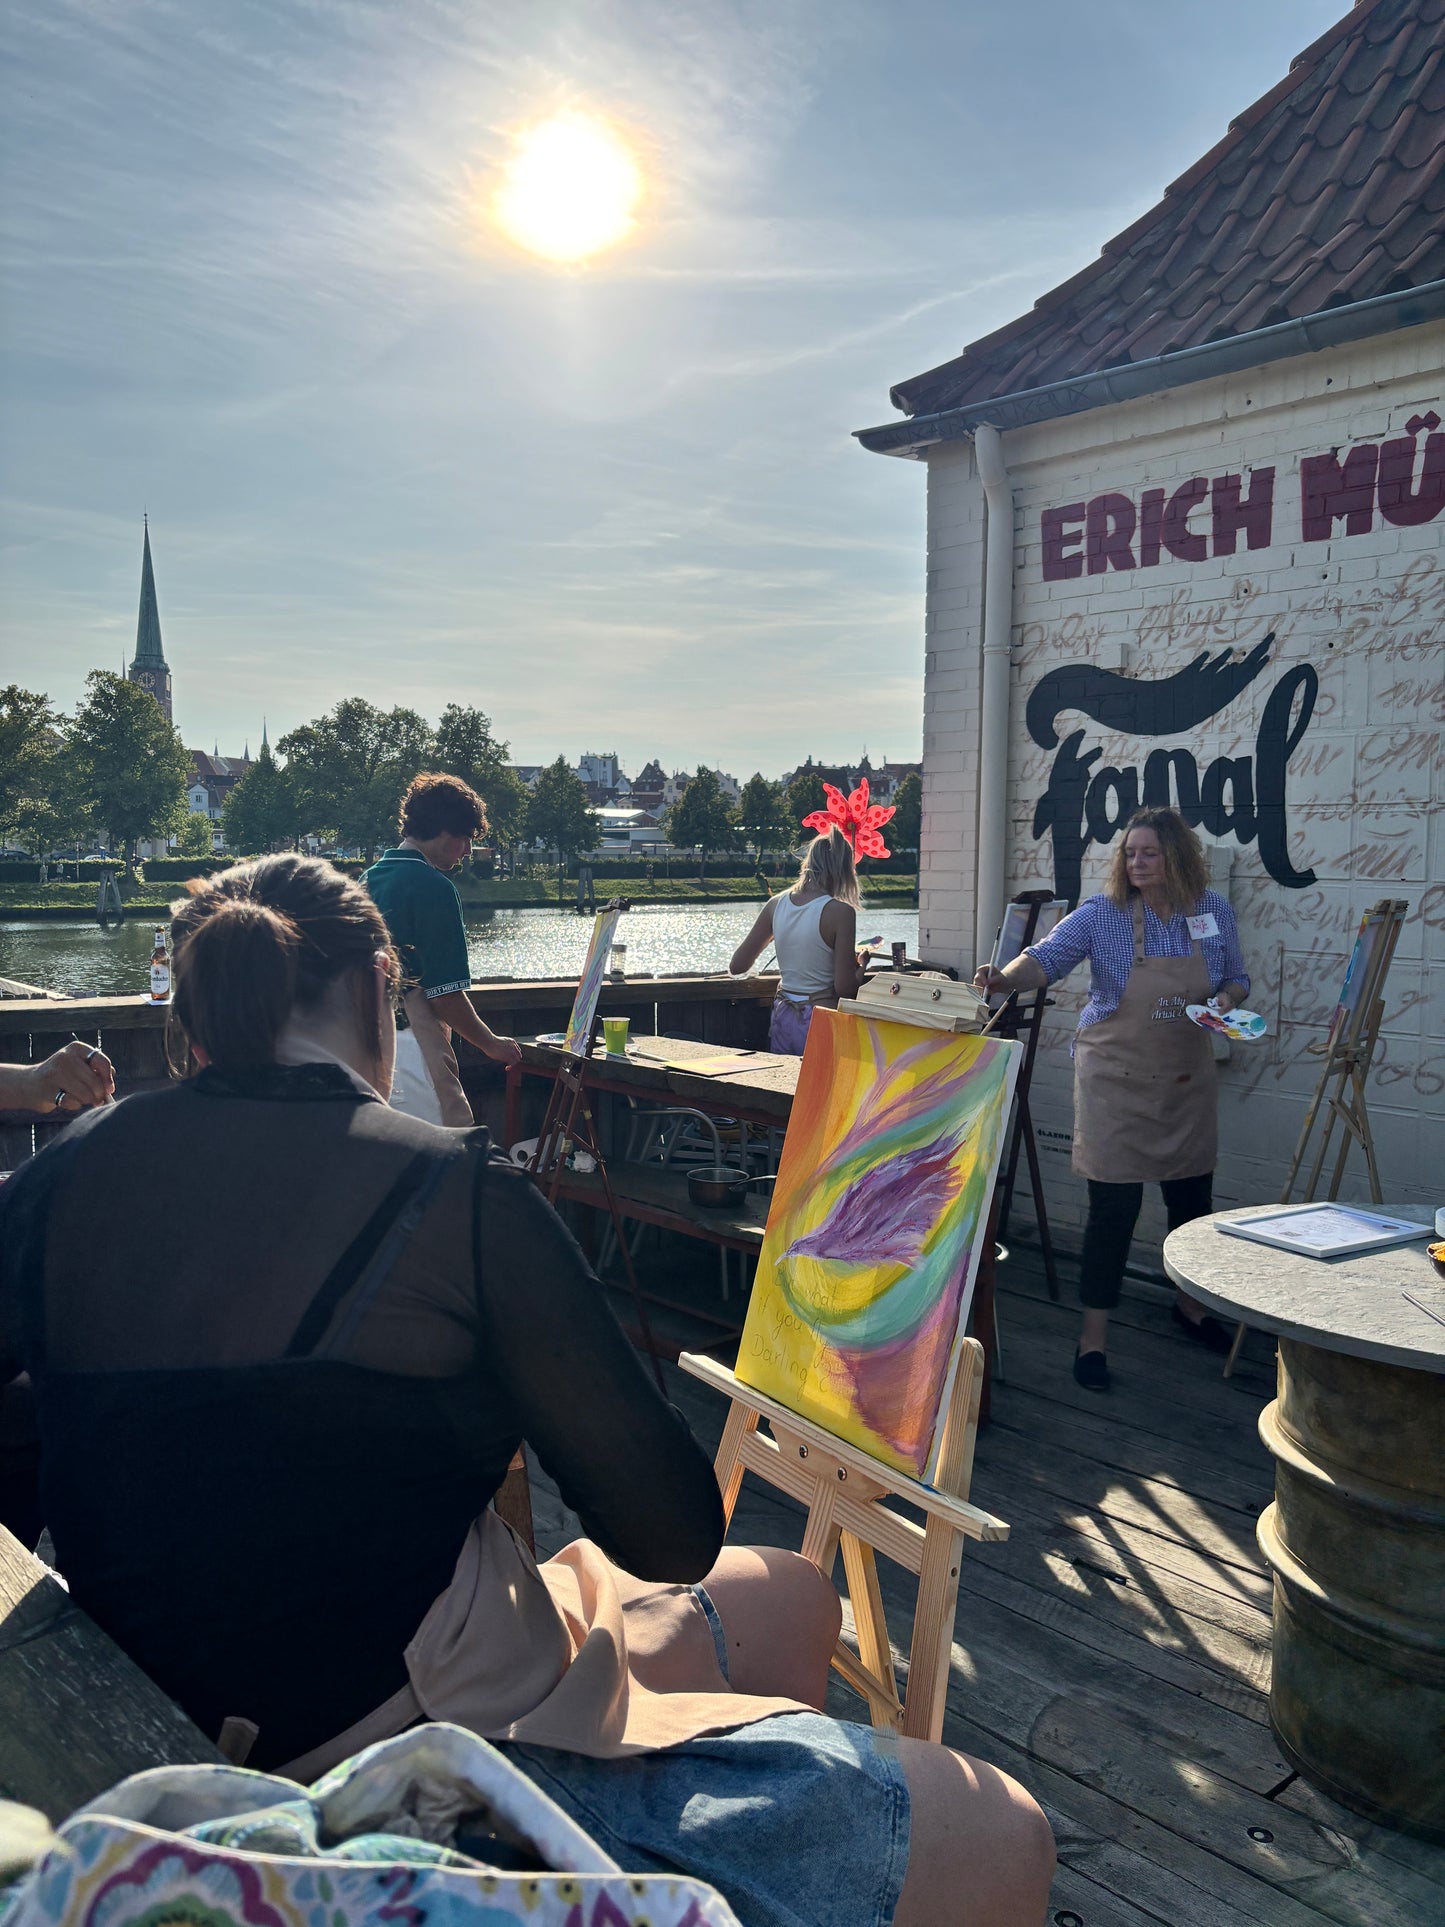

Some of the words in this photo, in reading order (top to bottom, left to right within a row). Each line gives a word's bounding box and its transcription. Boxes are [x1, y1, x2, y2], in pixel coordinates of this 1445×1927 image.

[1041, 466, 1276, 582] ERICH
[1026, 632, 1319, 912] Fanal
[771, 1311, 802, 1340] you
